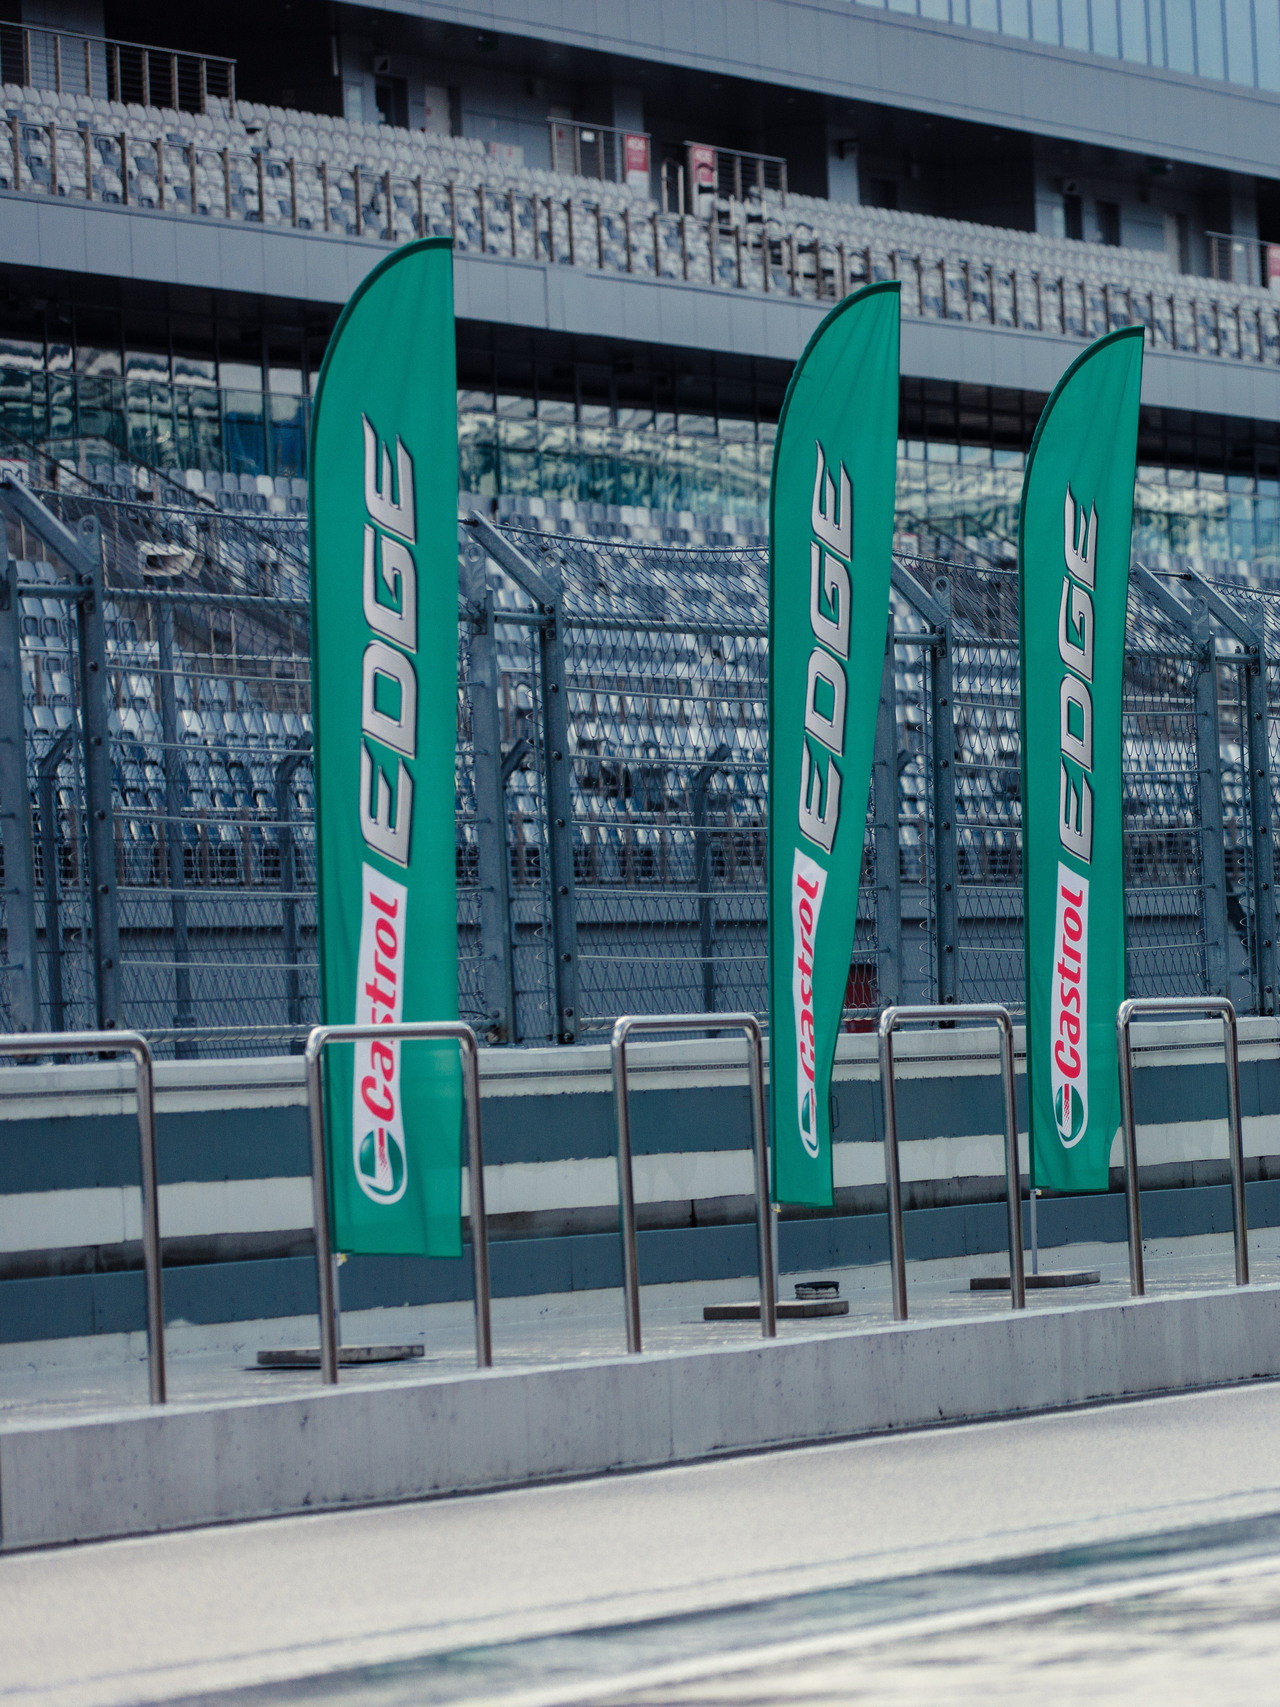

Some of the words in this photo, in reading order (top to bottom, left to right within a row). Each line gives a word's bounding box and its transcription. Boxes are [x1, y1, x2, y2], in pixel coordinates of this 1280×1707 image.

[360, 412, 417, 869] EDGE
[798, 440, 853, 855] EDGE
[1058, 481, 1098, 865] EDGE
[1055, 885, 1084, 1079] Castrol
